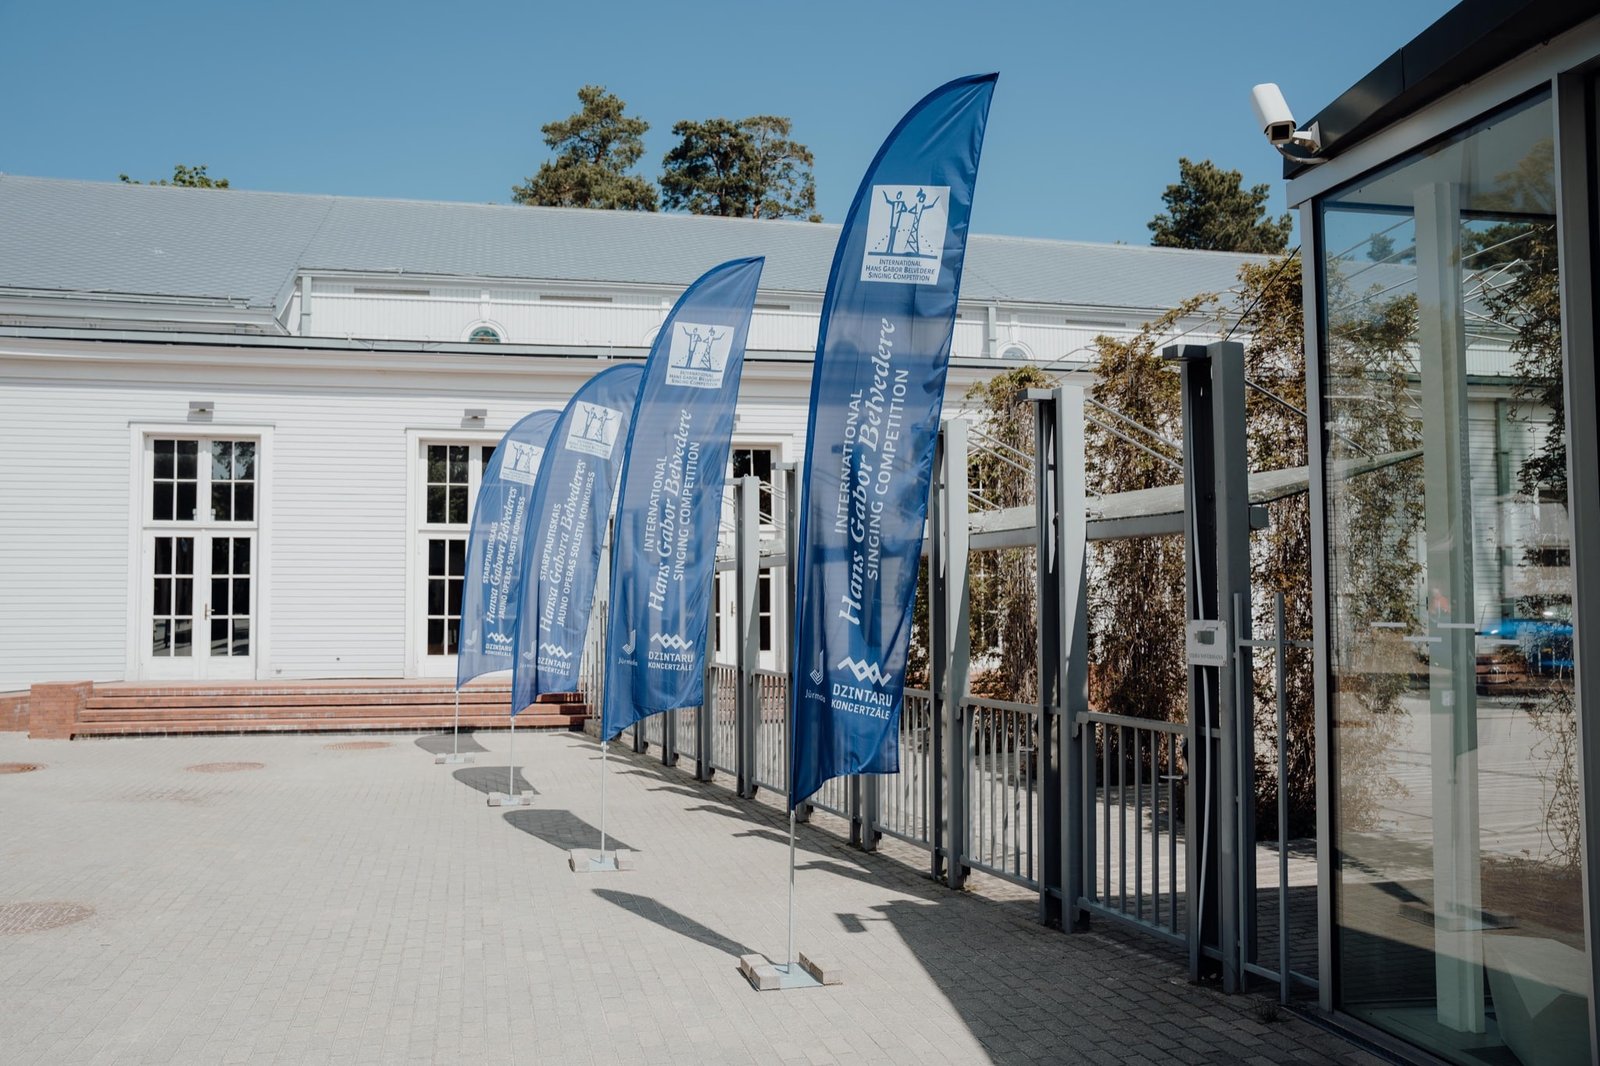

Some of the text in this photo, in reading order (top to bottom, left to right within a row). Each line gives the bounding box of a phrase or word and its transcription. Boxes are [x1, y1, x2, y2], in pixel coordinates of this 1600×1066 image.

[865, 265, 881, 273] HANS
[904, 267, 936, 275] BELVEDERE
[868, 272, 931, 281] SINGING COMPETITION
[879, 259, 922, 267] INTERNATIONAL
[643, 455, 668, 552] INTERNATIONAL
[834, 389, 863, 534] INTERNATIONAL
[838, 317, 896, 626] Hans Gabor Belvedere
[867, 369, 909, 581] SINGING COMPETITION
[482, 521, 498, 584] STARPTAUTISKAIS
[540, 503, 561, 581] STARPTAUTISKAIS
[540, 459, 587, 632] Hansa Gabora Belvederes
[557, 471, 595, 627] JAUNO OPERAS SOLISTU KONKURSS
[648, 409, 692, 612] Hans Gabor Belvedere
[673, 441, 700, 582] SINGING COMPETITION
[486, 486, 517, 624] Hansa Gabora Belvederes
[502, 566, 513, 594] OPERAS
[648, 651, 694, 663] DZINTARU
[832, 683, 893, 708] DZINTARU
[830, 699, 892, 721] KONCERTZĀLE
